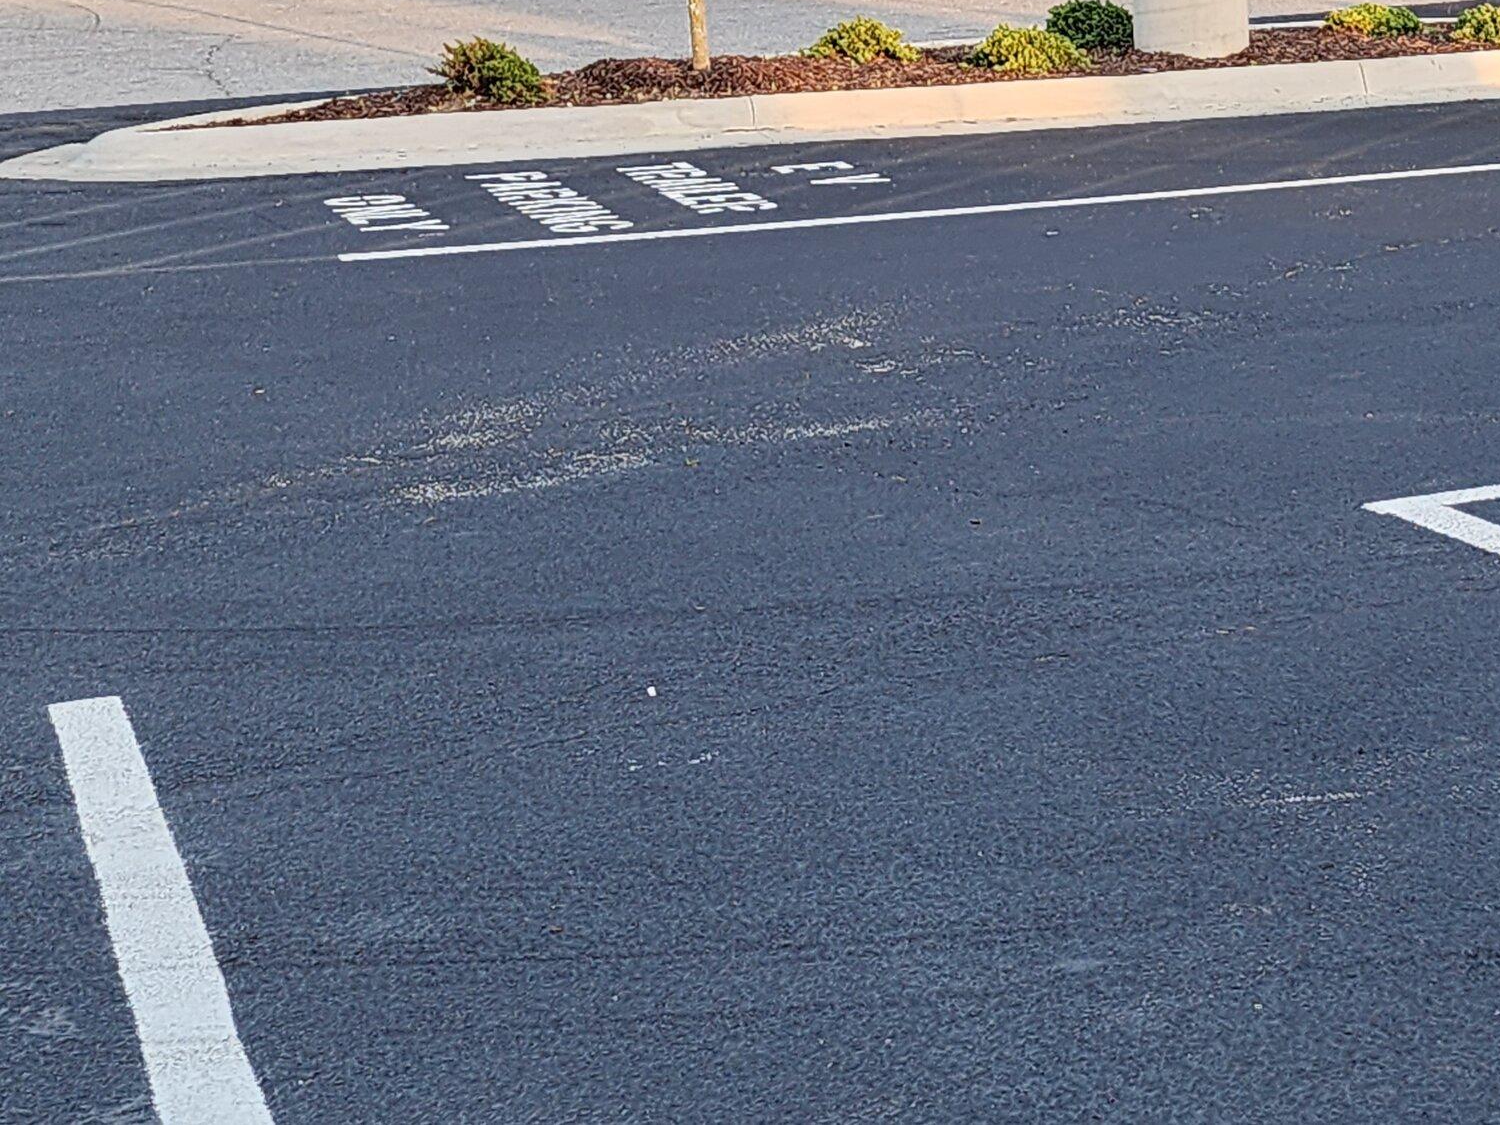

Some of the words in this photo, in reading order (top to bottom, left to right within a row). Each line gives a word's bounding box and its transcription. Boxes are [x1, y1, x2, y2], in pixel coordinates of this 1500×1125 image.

[616, 162, 778, 214] TRAILER
[770, 161, 891, 185] EV
[323, 195, 450, 232] ONLY
[464, 171, 634, 232] PARKING
